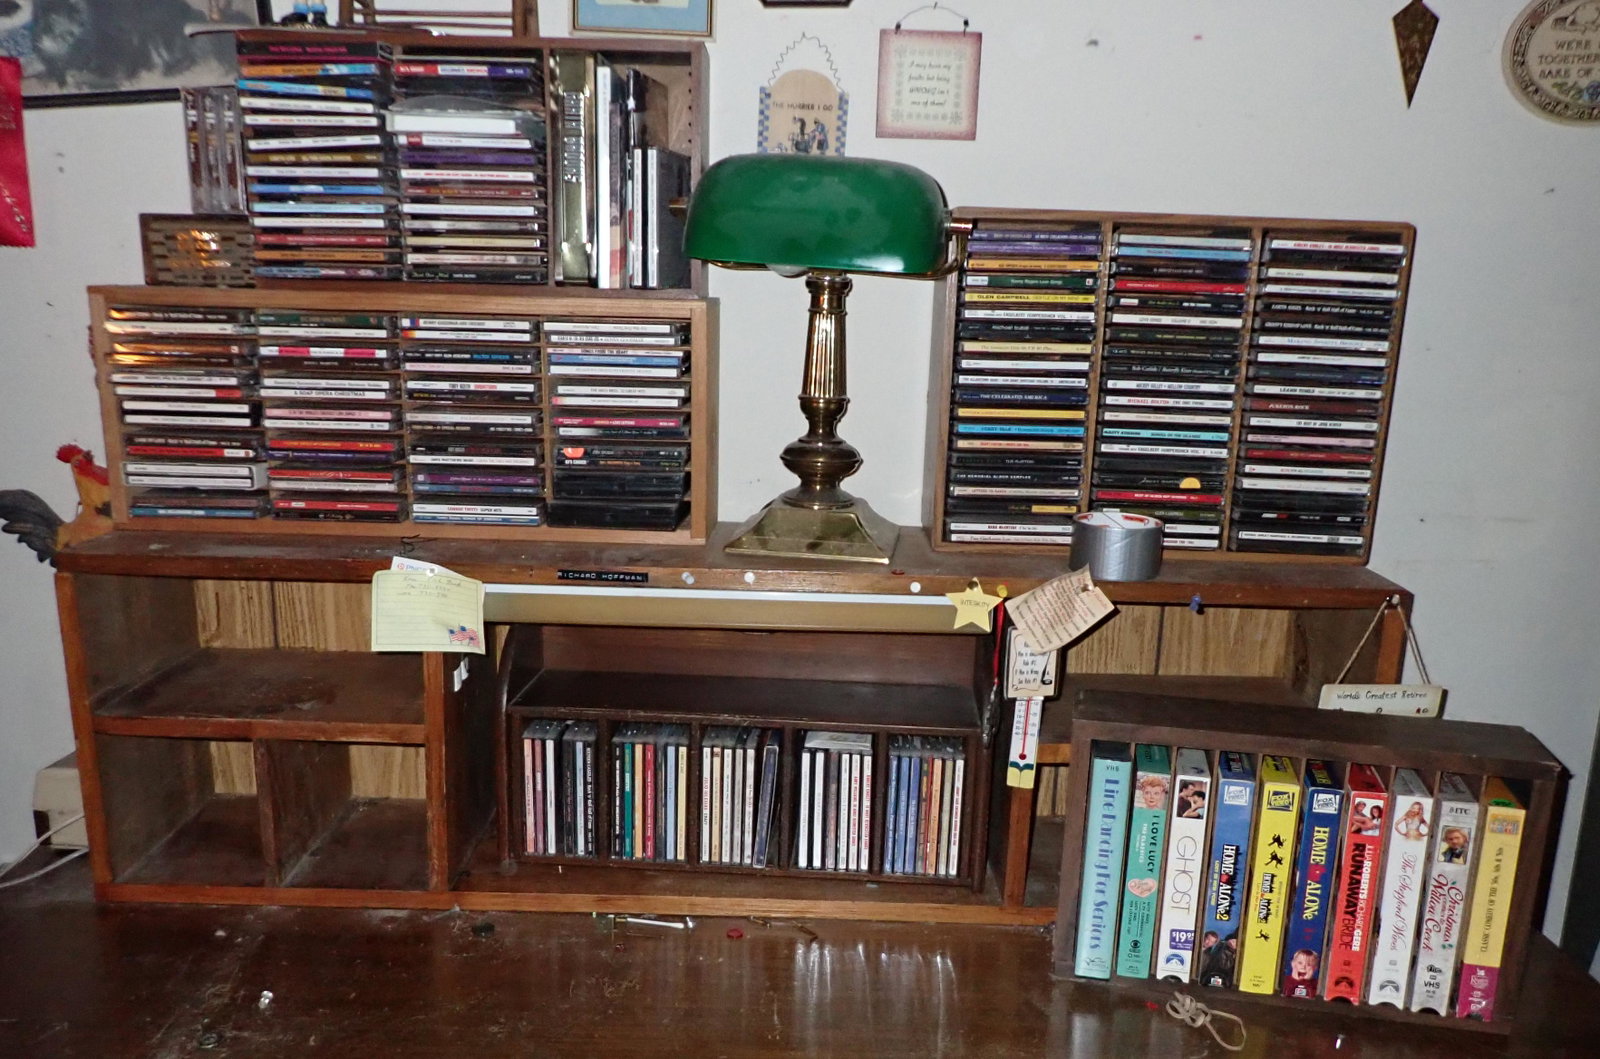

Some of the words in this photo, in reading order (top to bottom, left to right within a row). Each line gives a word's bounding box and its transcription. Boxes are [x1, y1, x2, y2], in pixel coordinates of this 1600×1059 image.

[556, 571, 597, 579] RICHARD
[601, 573, 643, 581] HOFFMAN
[1365, 690, 1398, 700] Greatest
[1102, 779, 1120, 812] Line
[1094, 814, 1116, 870] Dancing
[1149, 822, 1159, 847] LOVE
[1310, 826, 1330, 865] HOME
[1147, 850, 1157, 873] LUCY
[1171, 836, 1196, 915] GHOST
[1221, 844, 1237, 875] HOME
[1401, 852, 1417, 874] The
[1095, 872, 1111, 894] For
[1261, 873, 1273, 894] HOME
[1343, 843, 1366, 919] RUNAWAY
[1359, 860, 1372, 900] ROBERTS
[1426, 874, 1448, 916] Willow
[1392, 874, 1413, 920] Stepford
[1089, 900, 1109, 950] Seniors
[1442, 886, 1464, 944] Christmas
[1338, 918, 1354, 950] BRIDE
[1351, 929, 1362, 952] GERE
[1390, 919, 1407, 951] Wives
[1422, 917, 1441, 952] Creek
[1423, 980, 1441, 989] VHS
